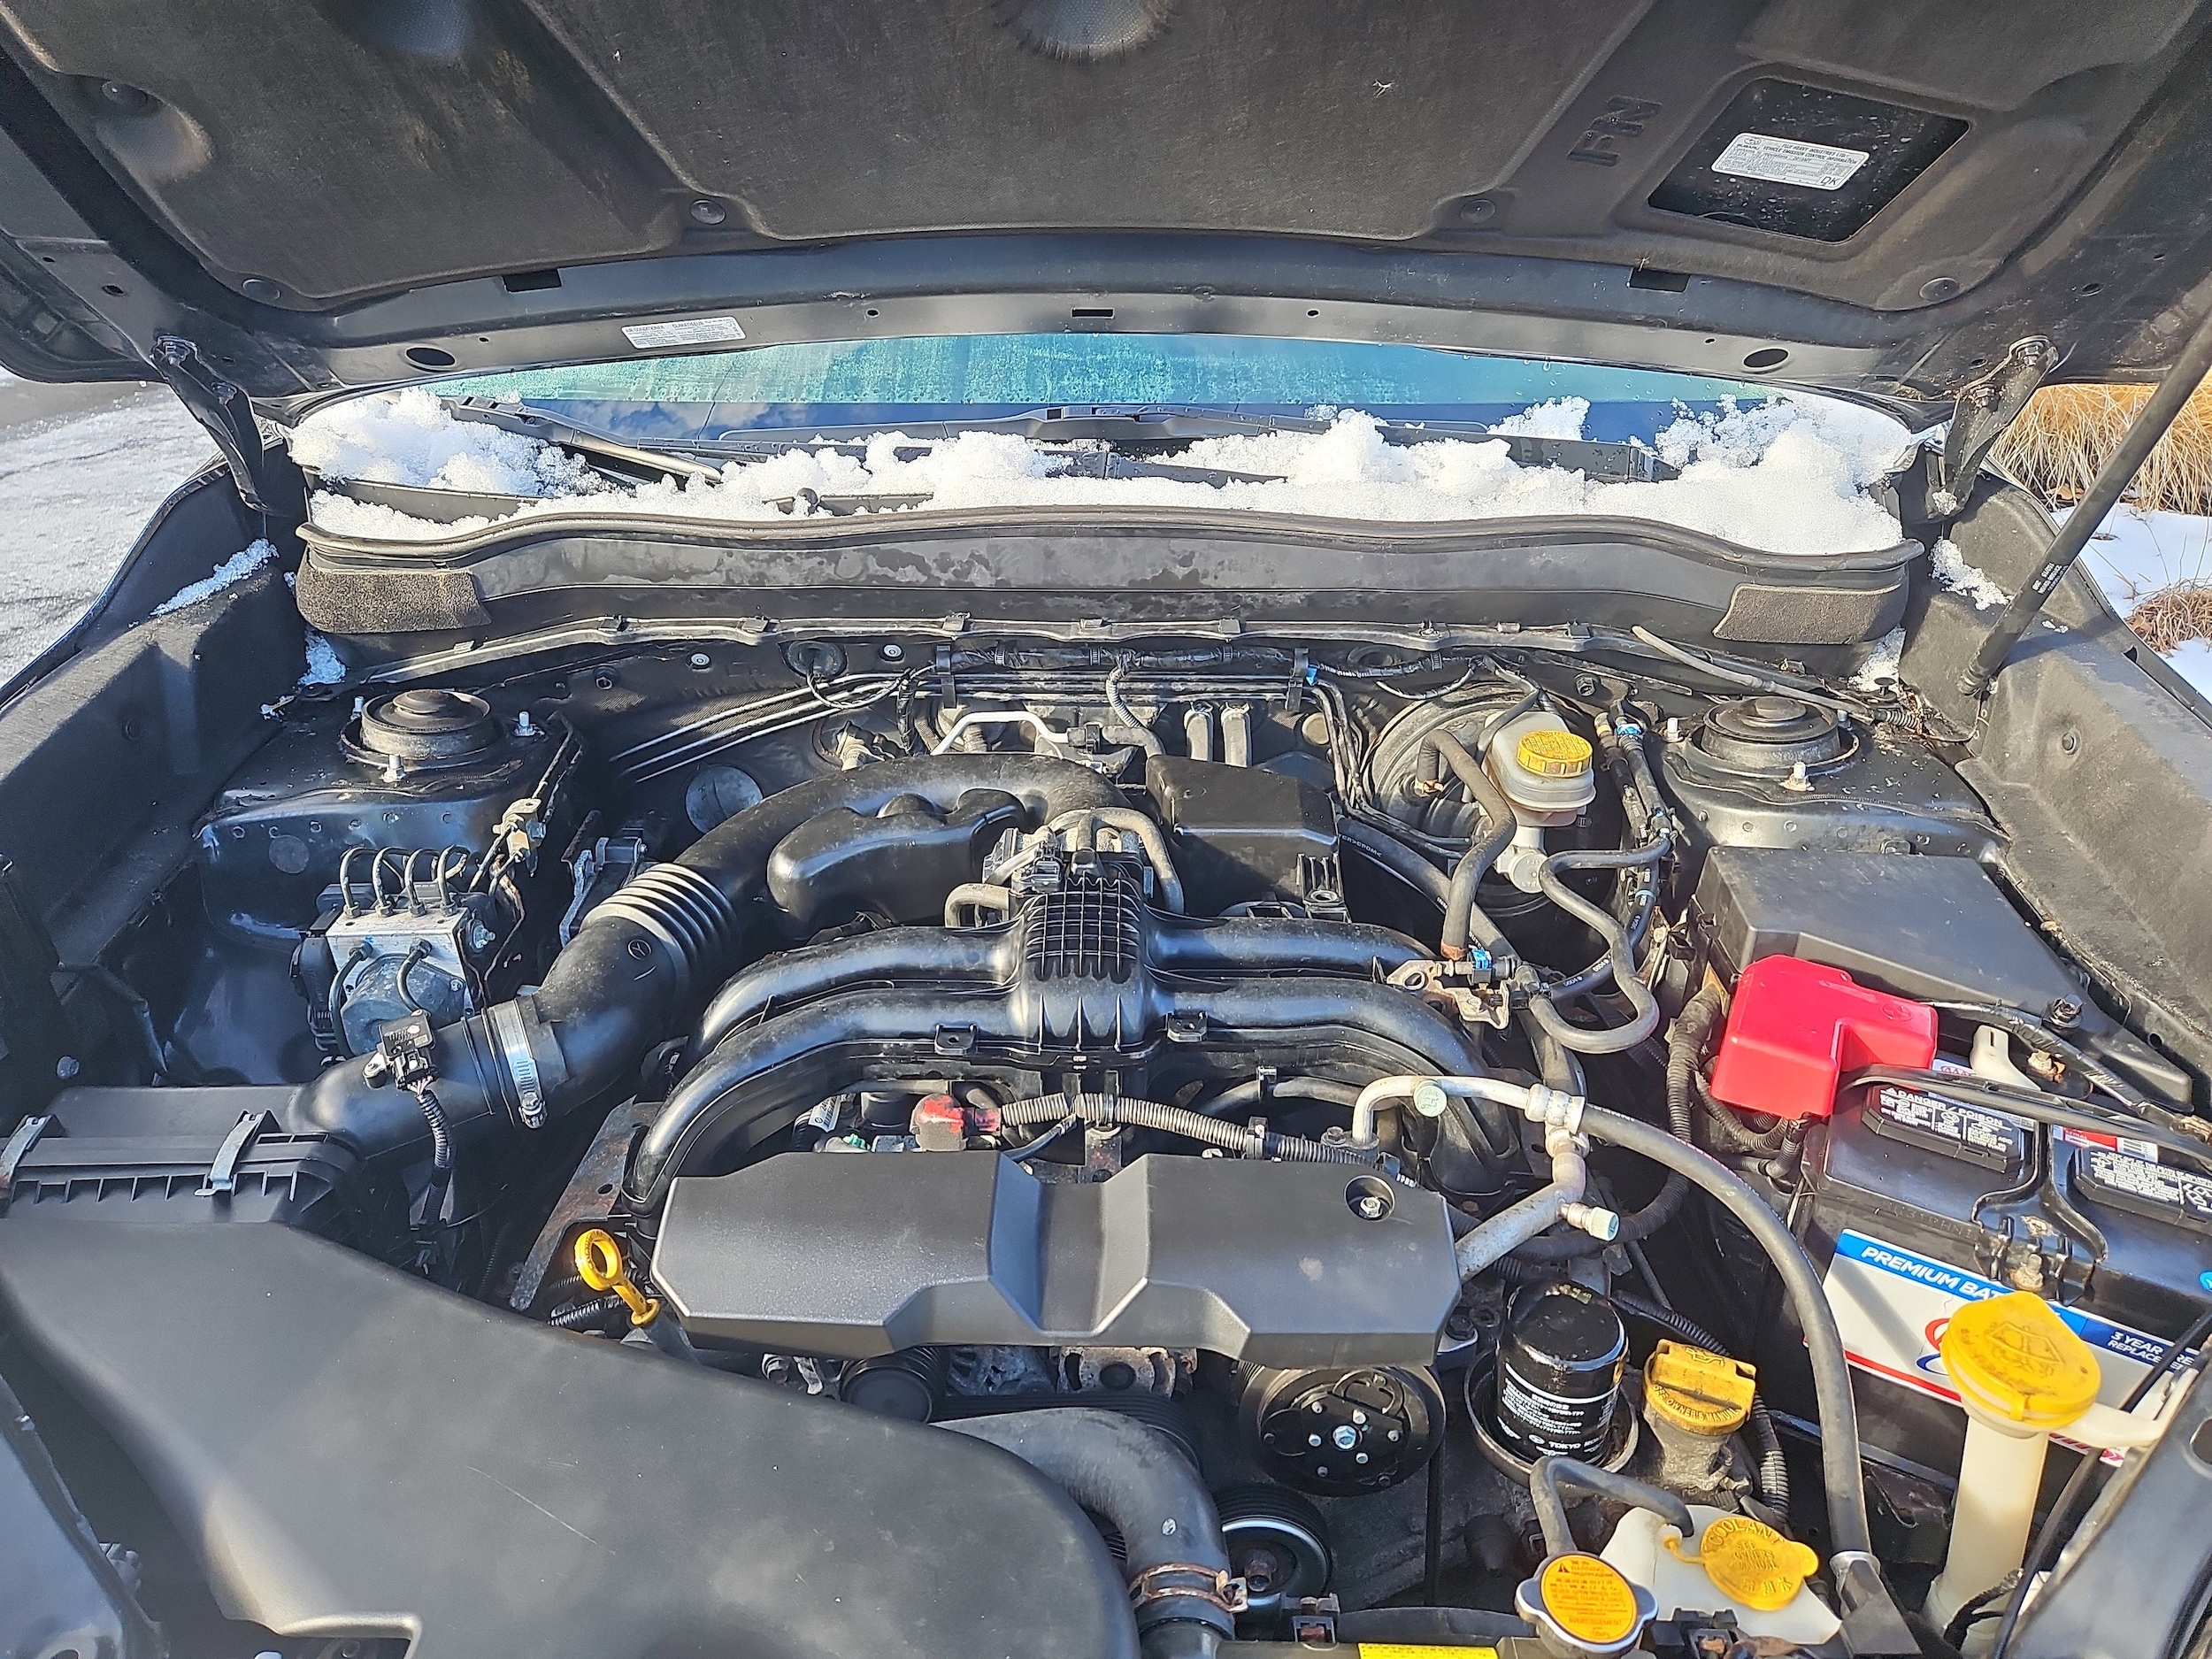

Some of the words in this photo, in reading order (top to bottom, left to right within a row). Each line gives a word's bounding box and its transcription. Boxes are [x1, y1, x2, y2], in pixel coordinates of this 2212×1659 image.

[1896, 1089, 1947, 1110] DANGER
[1958, 1109, 2003, 1126] POISON
[1861, 1246, 1962, 1290] PREMIUM
[2110, 1331, 2124, 1340] 3
[2124, 1334, 2164, 1355] YEAR
[1653, 1384, 1670, 1399] SEE
[1666, 1398, 1704, 1421] OWNER'S
[1705, 1407, 1740, 1422] MANUAL
[1548, 1440, 1582, 1450] TOKYO
[1708, 1519, 1785, 1547] COOLANT
[1735, 1540, 1755, 1550] SEE
[1738, 1559, 1779, 1571] MANUAL
